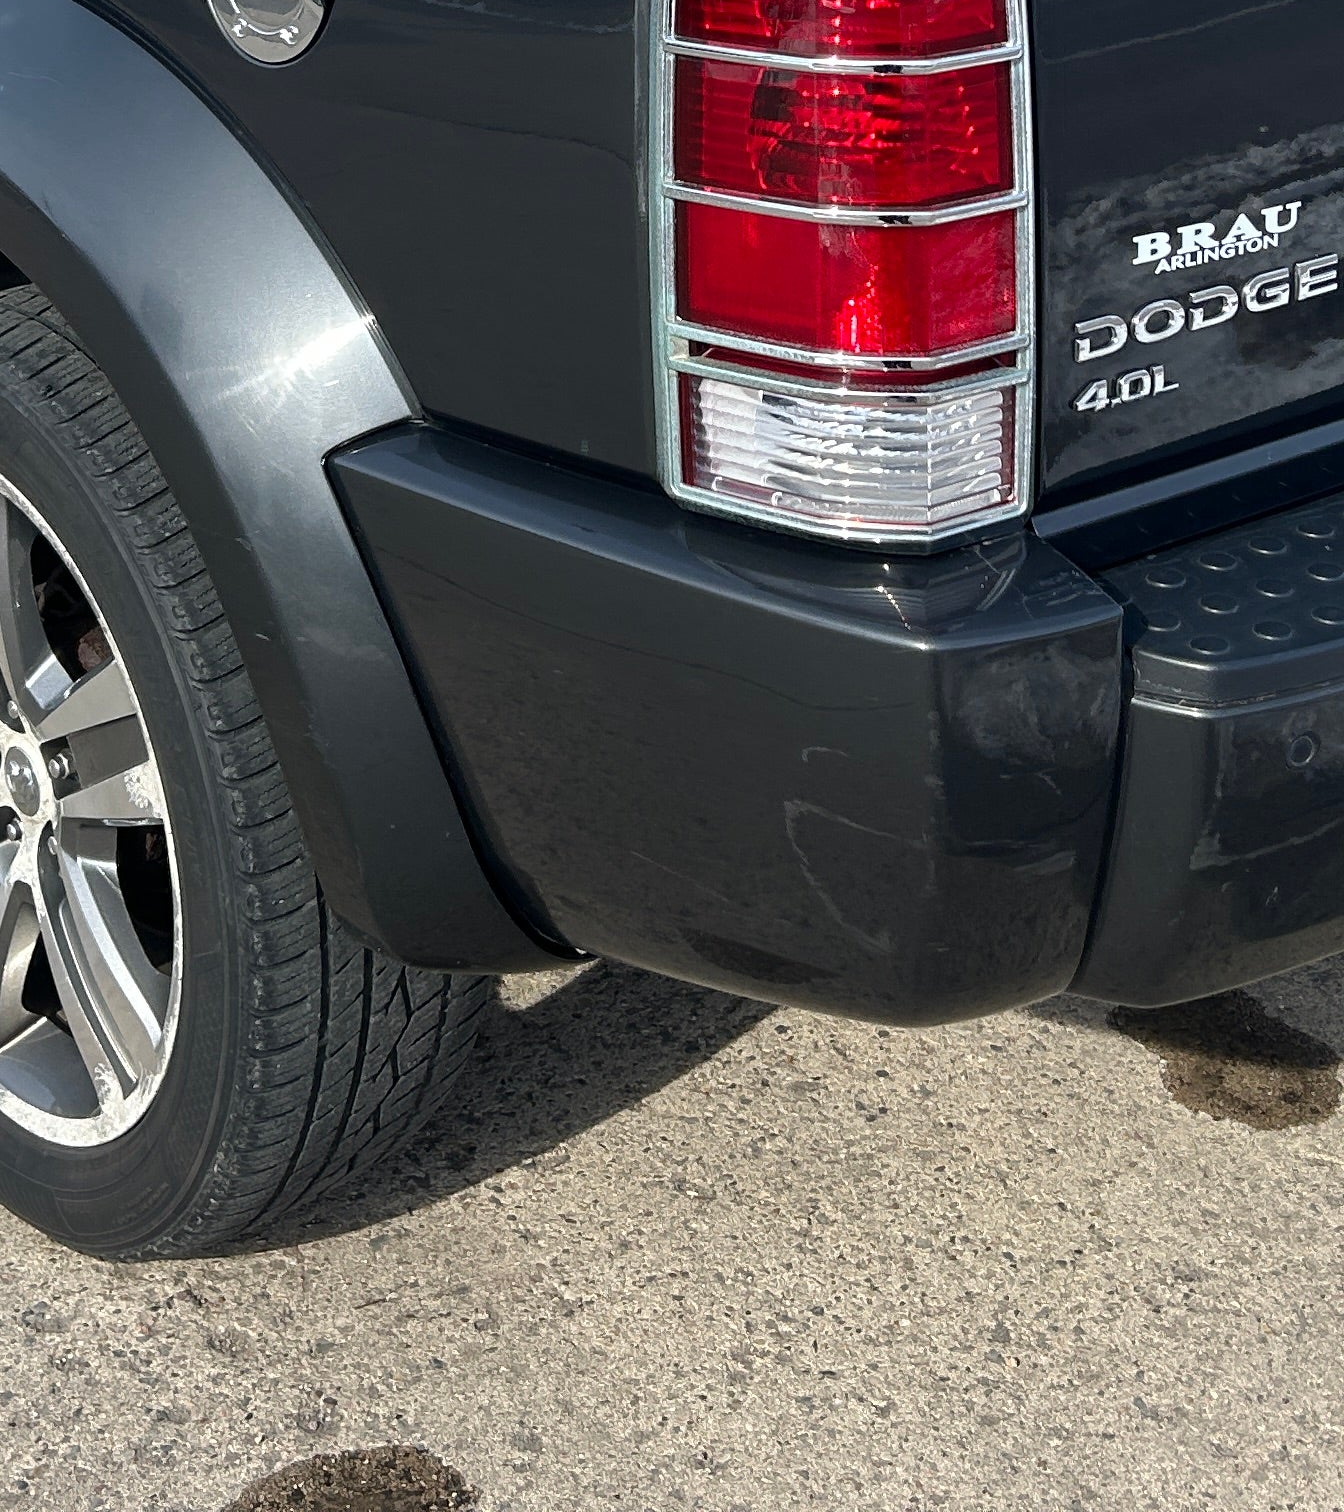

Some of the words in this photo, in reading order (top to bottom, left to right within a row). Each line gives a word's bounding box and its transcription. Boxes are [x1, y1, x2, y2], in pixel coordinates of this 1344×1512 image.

[1132, 200, 1303, 266] BRAU
[1154, 233, 1280, 275] ARLINGTON
[1074, 253, 1340, 363] DODGE
[1073, 365, 1180, 412] 4.0L
